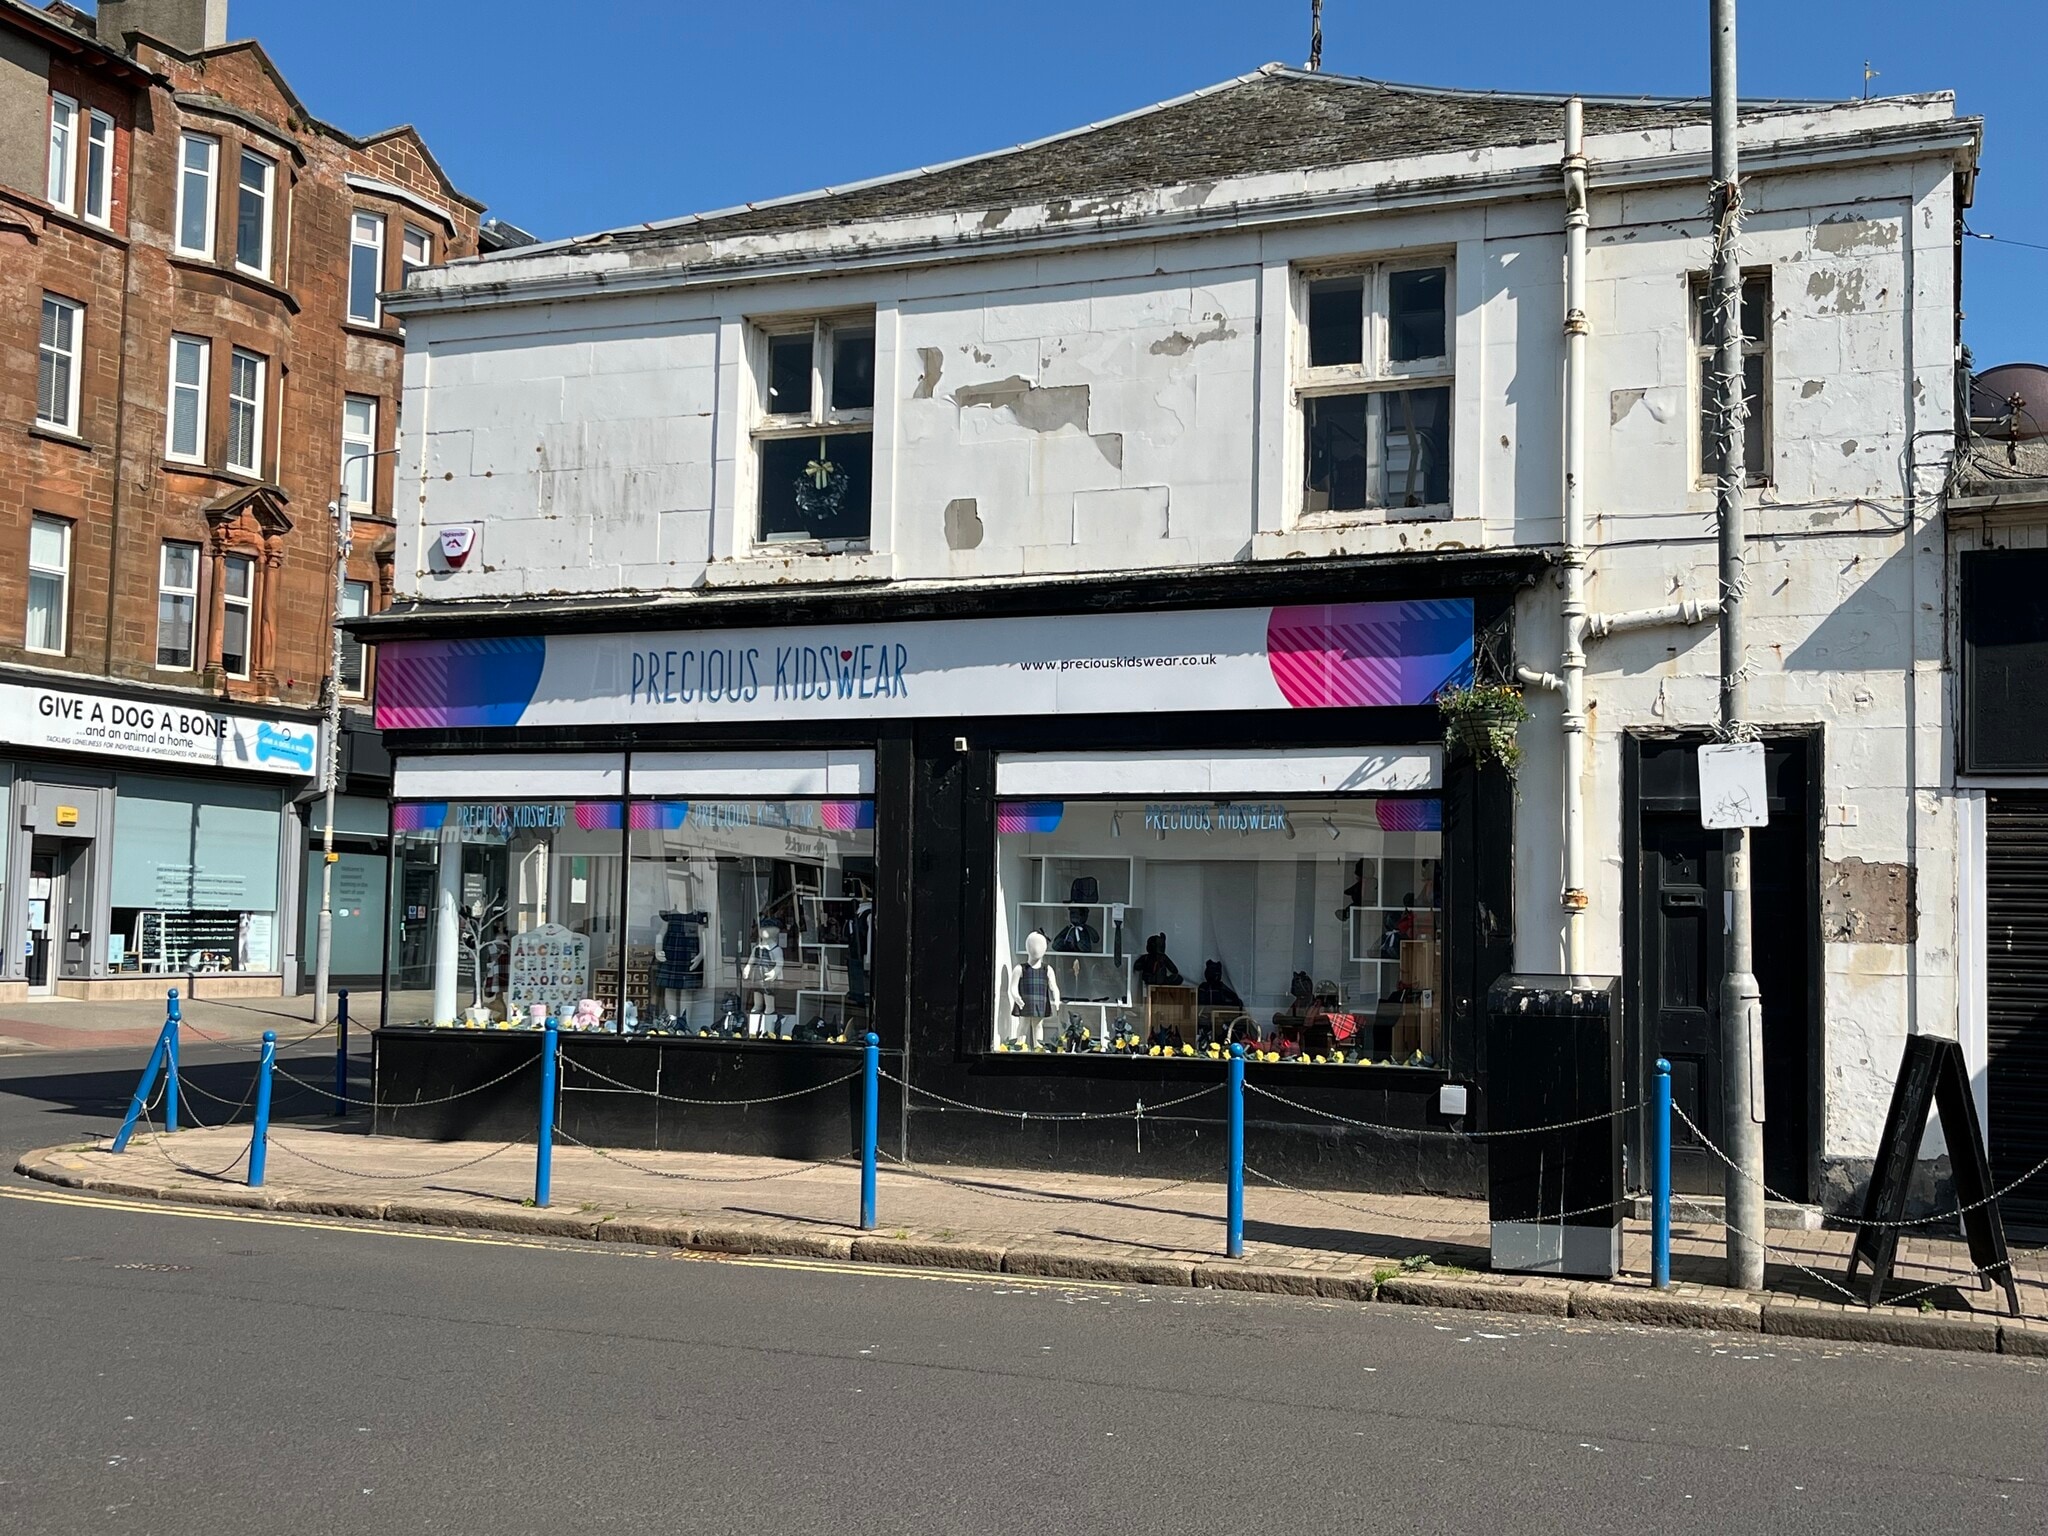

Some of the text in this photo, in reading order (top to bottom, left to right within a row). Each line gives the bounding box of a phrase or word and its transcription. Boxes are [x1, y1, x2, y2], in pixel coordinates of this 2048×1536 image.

[630, 643, 908, 705] PRECIOUS KIDSWEAR
[1020, 653, 1217, 672] www.preciouskidswear.co.uk
[39, 695, 227, 738] GIVE A DOG A BONE
[46, 735, 71, 744] TACKLING
[72, 738, 102, 748] LONELINESS
[103, 741, 114, 749] FOR
[108, 729, 121, 739] an
[123, 730, 156, 743] animal
[158, 736, 165, 745] a
[167, 734, 194, 748] home
[456, 805, 566, 828] PRECIOUS KIDSWEAR
[695, 804, 750, 827] PRECIOUS
[1145, 804, 1286, 830] PRECIOUS KIDSWEAR
